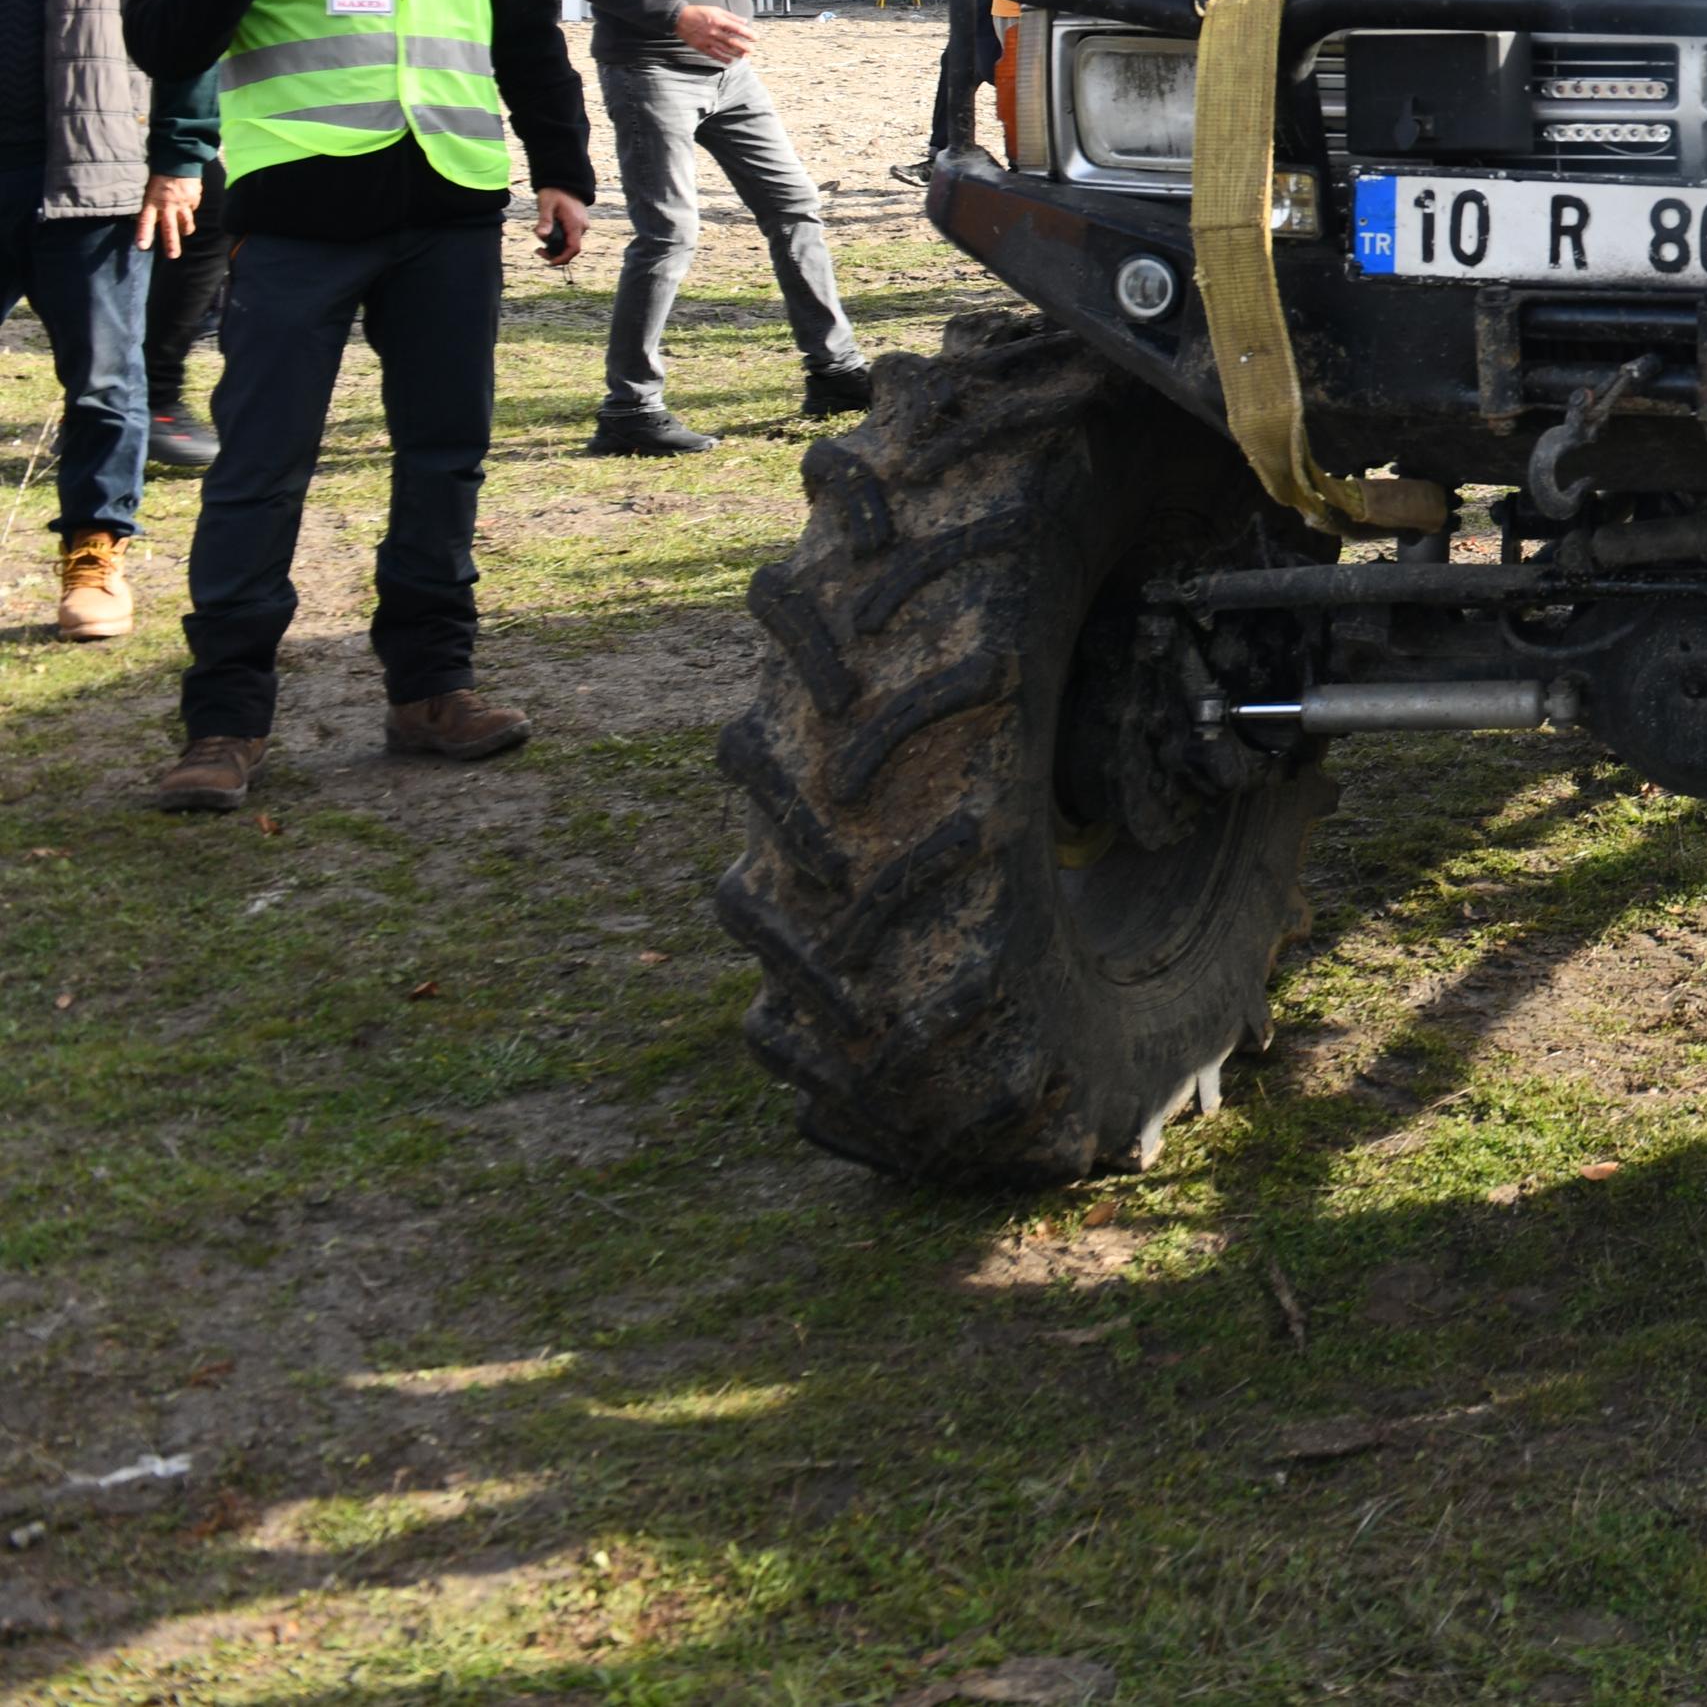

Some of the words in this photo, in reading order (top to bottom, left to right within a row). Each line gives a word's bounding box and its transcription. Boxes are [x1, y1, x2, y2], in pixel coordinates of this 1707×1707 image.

[1359, 231, 1392, 255] TR
[1413, 188, 1490, 269] 10
[1549, 193, 1592, 270] R
